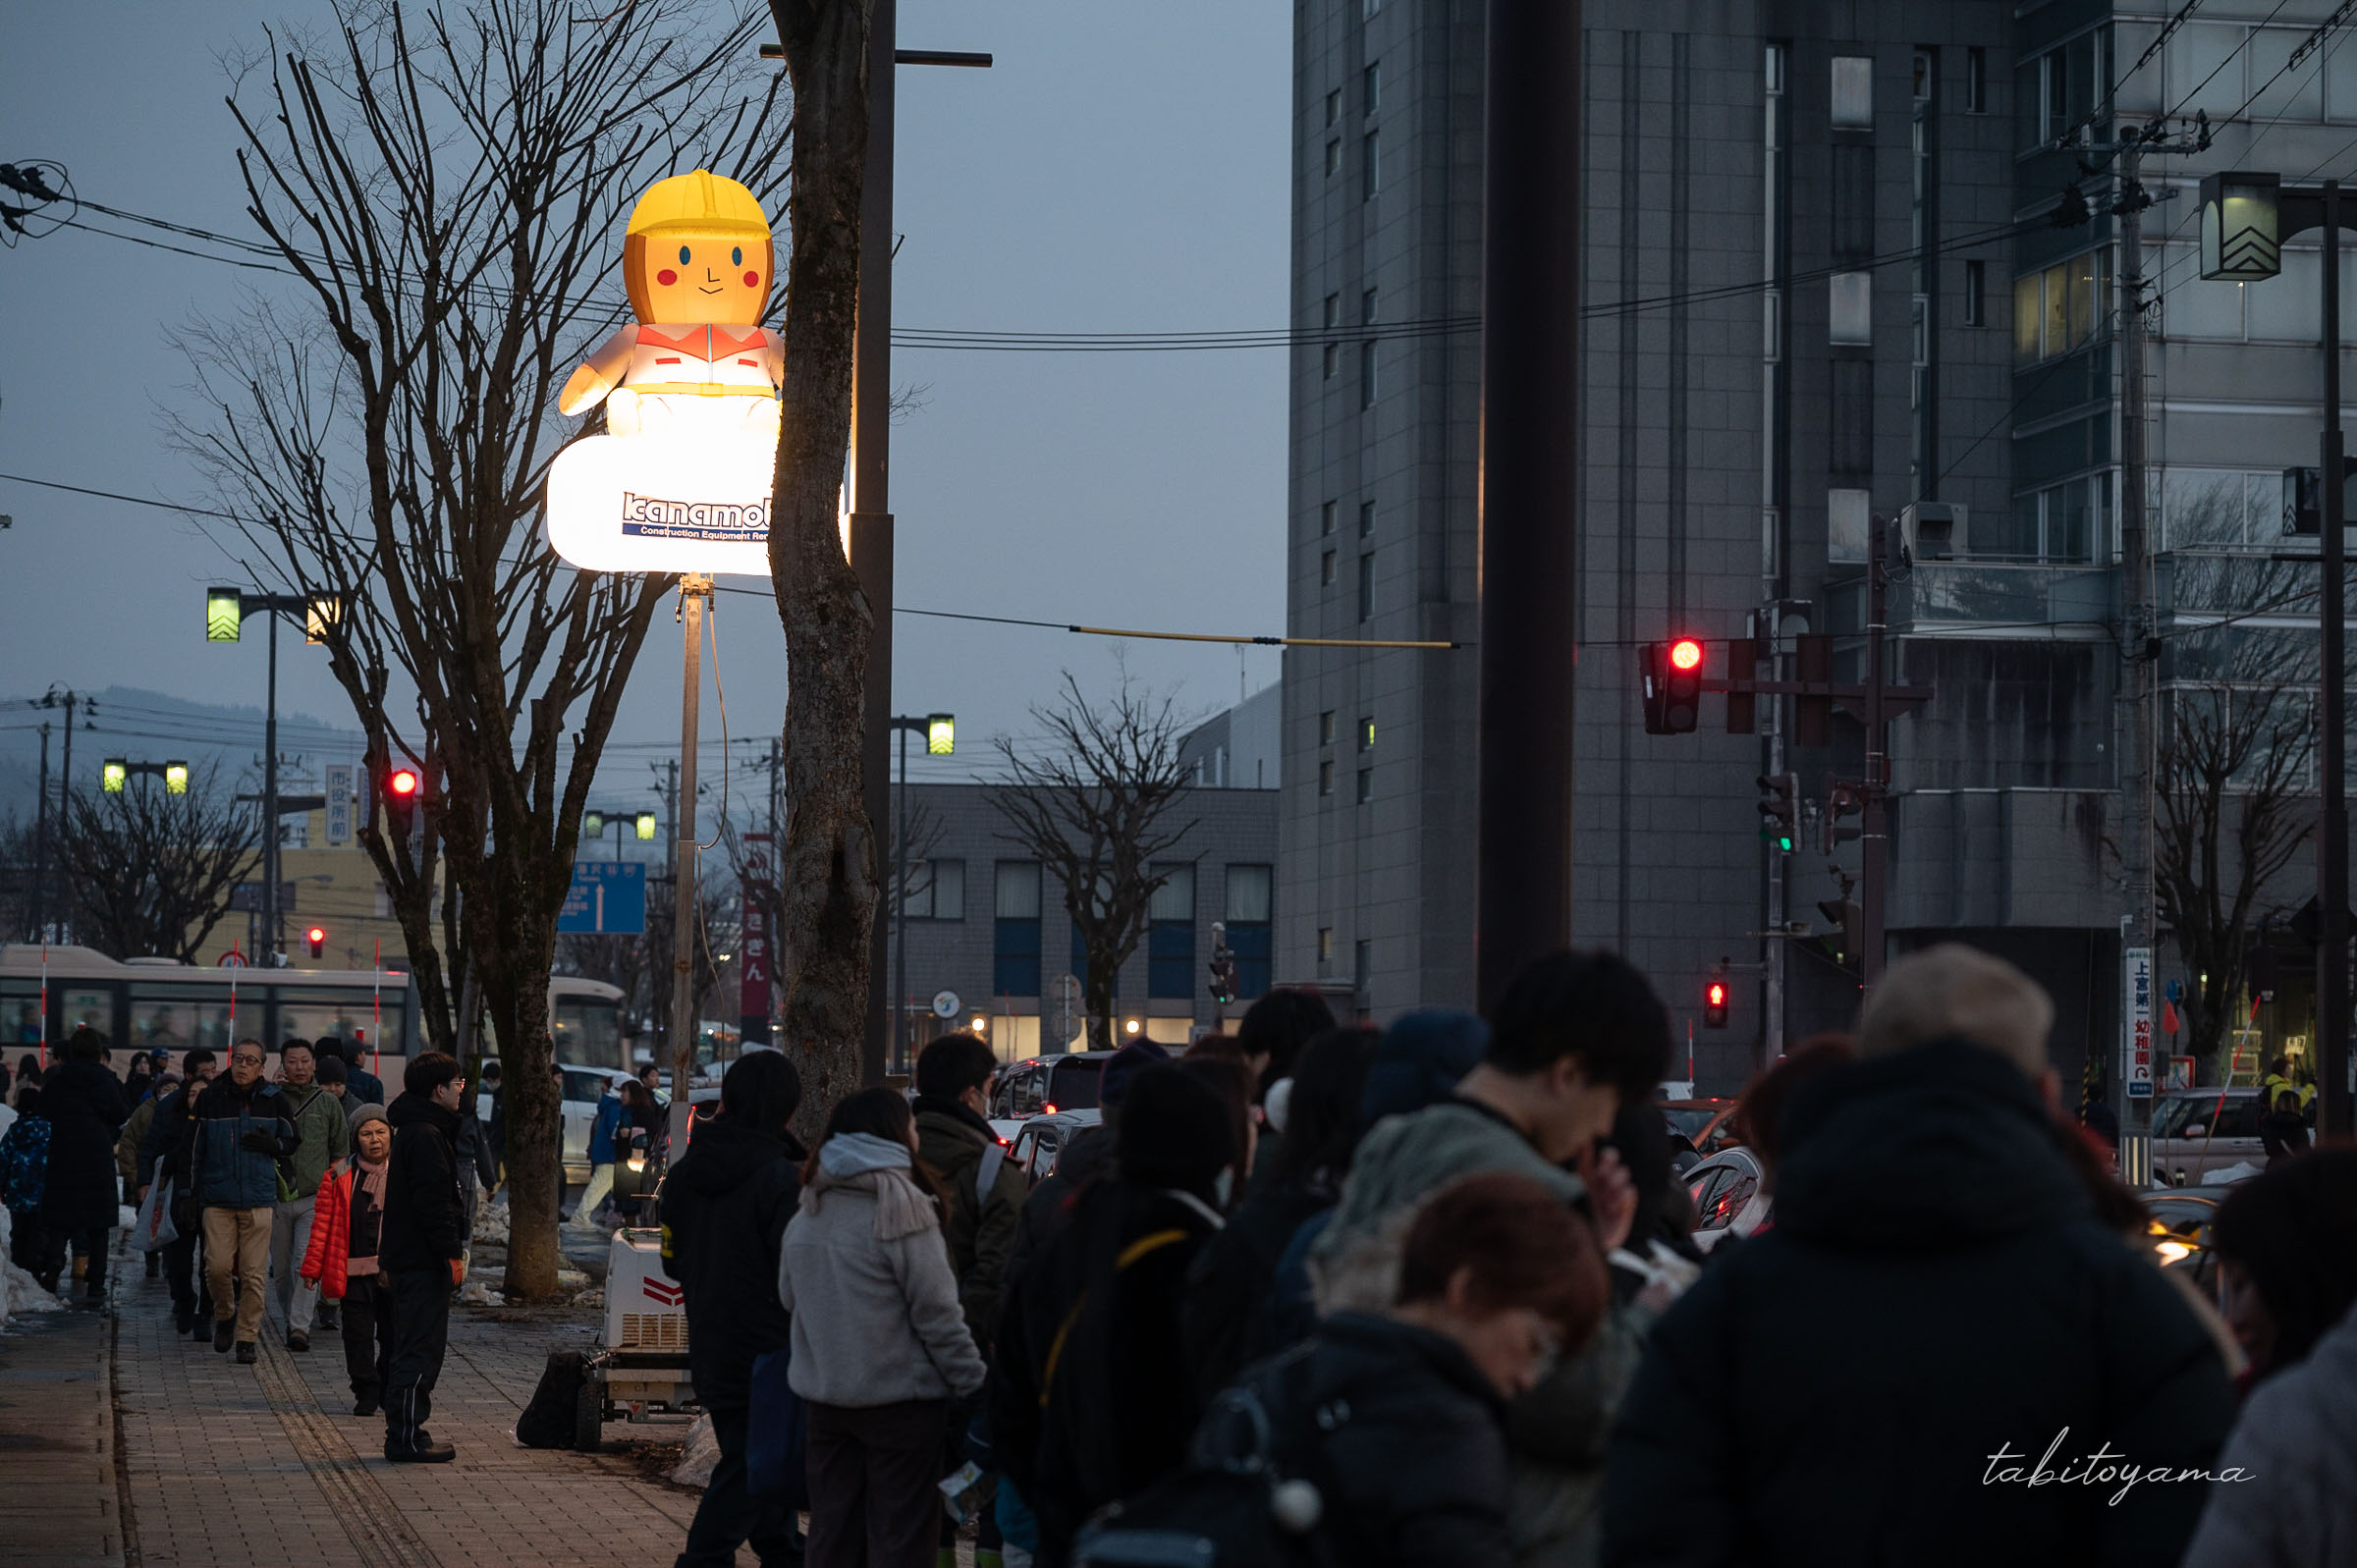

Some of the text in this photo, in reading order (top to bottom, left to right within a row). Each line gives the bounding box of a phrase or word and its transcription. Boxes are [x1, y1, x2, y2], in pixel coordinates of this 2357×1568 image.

[640, 526, 699, 538] Construction
[702, 531, 750, 541] Equipment
[331, 772, 346, 837] 市役所前
[2135, 961, 2150, 1065] 上宮第一幼稚園
